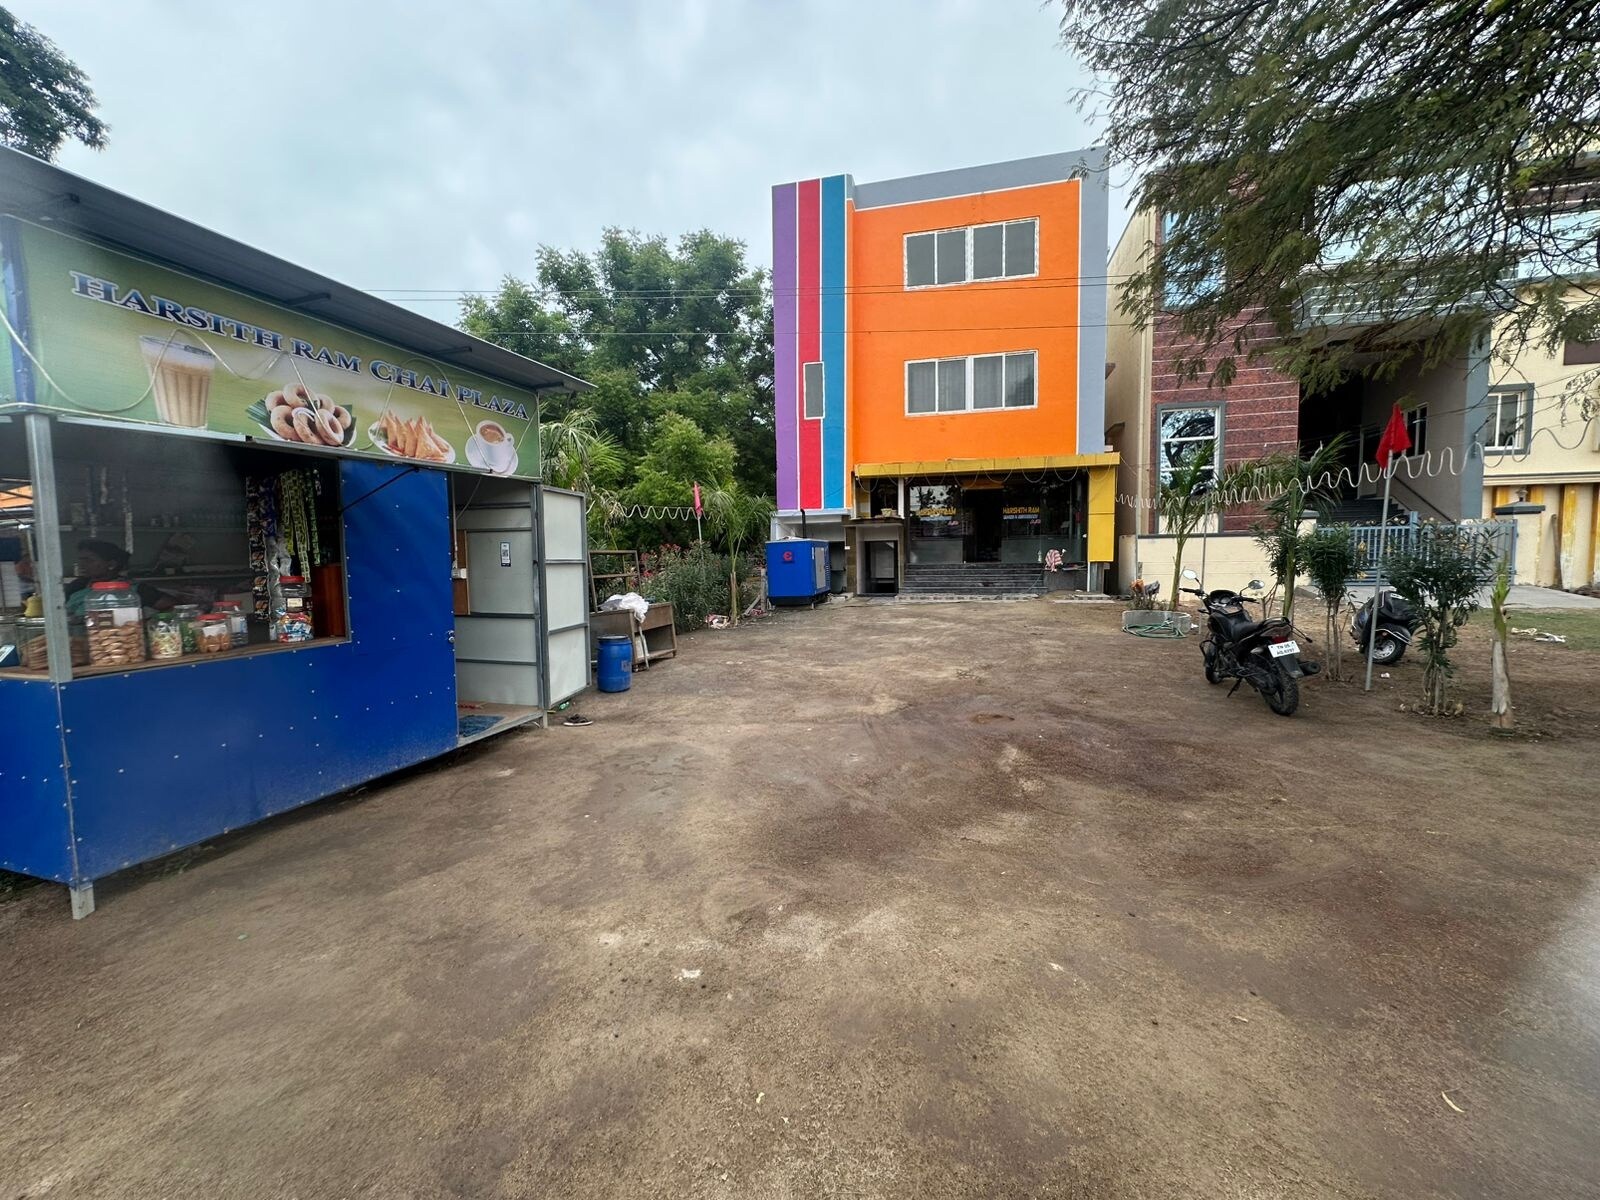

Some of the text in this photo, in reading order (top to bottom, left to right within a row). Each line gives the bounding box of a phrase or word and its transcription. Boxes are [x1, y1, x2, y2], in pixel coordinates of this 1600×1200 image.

[69, 270, 530, 421] HARSITH RAM CHAI PLAZA
